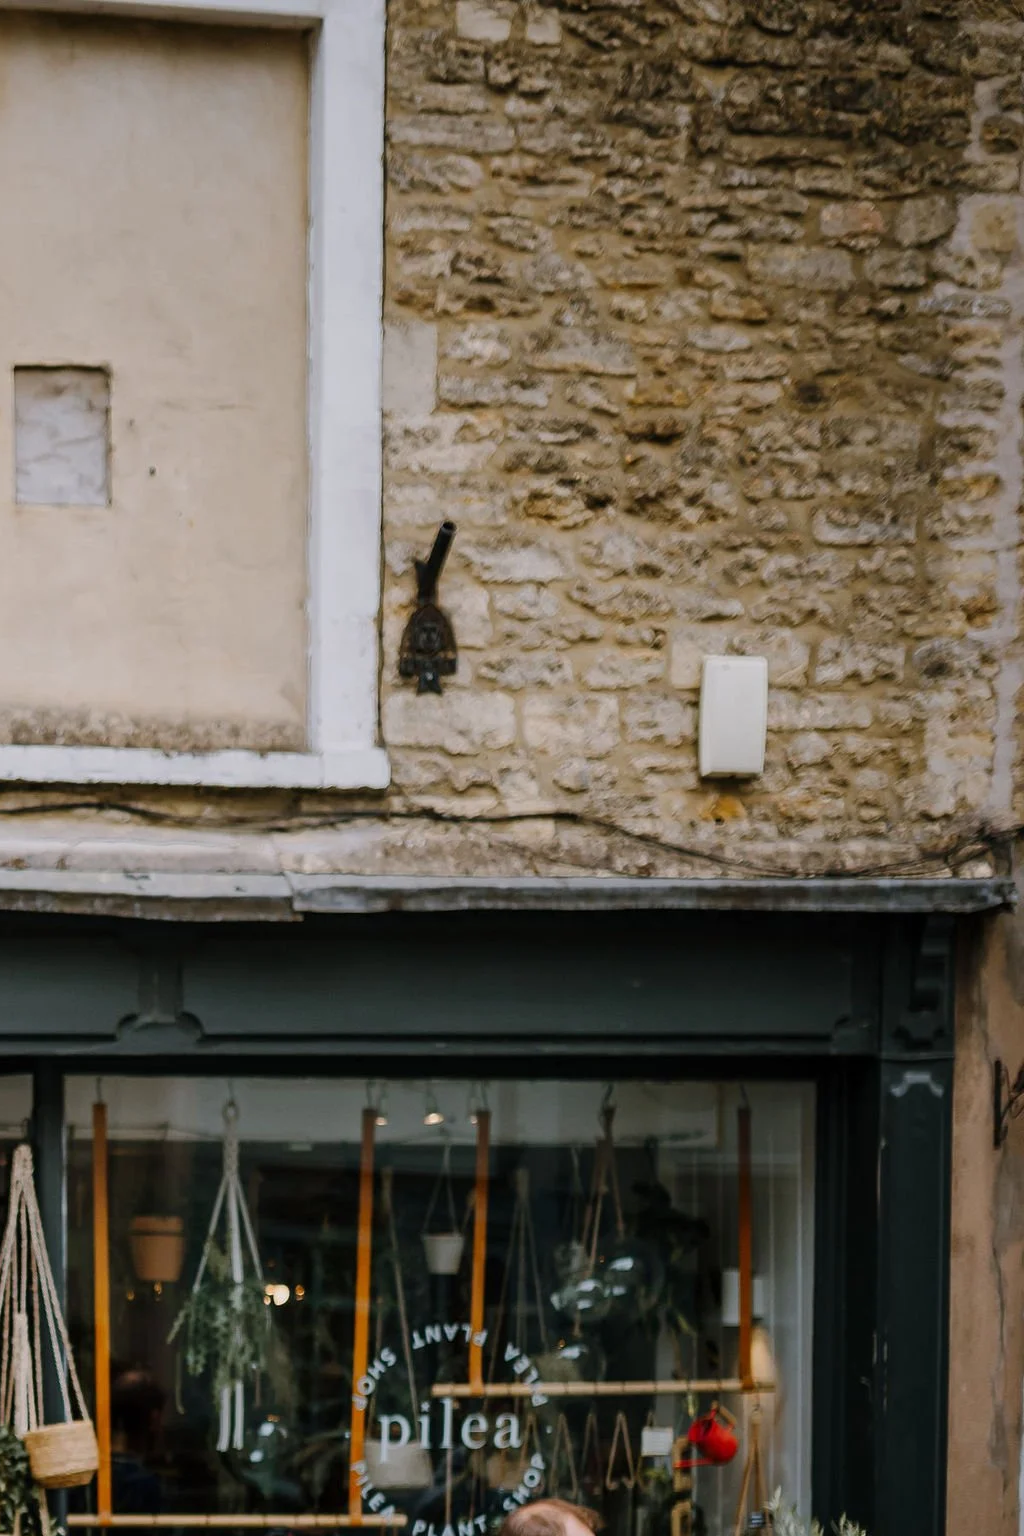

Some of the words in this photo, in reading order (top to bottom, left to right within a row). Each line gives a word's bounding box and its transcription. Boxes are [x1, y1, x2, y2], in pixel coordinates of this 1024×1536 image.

[412, 1322, 488, 1350] PLANT
[352, 1346, 397, 1411] SHOP
[504, 1341, 549, 1407] PILEA
[378, 1397, 523, 1463] pilea
[350, 1460, 396, 1526] PILEA
[502, 1452, 546, 1512] SHOP
